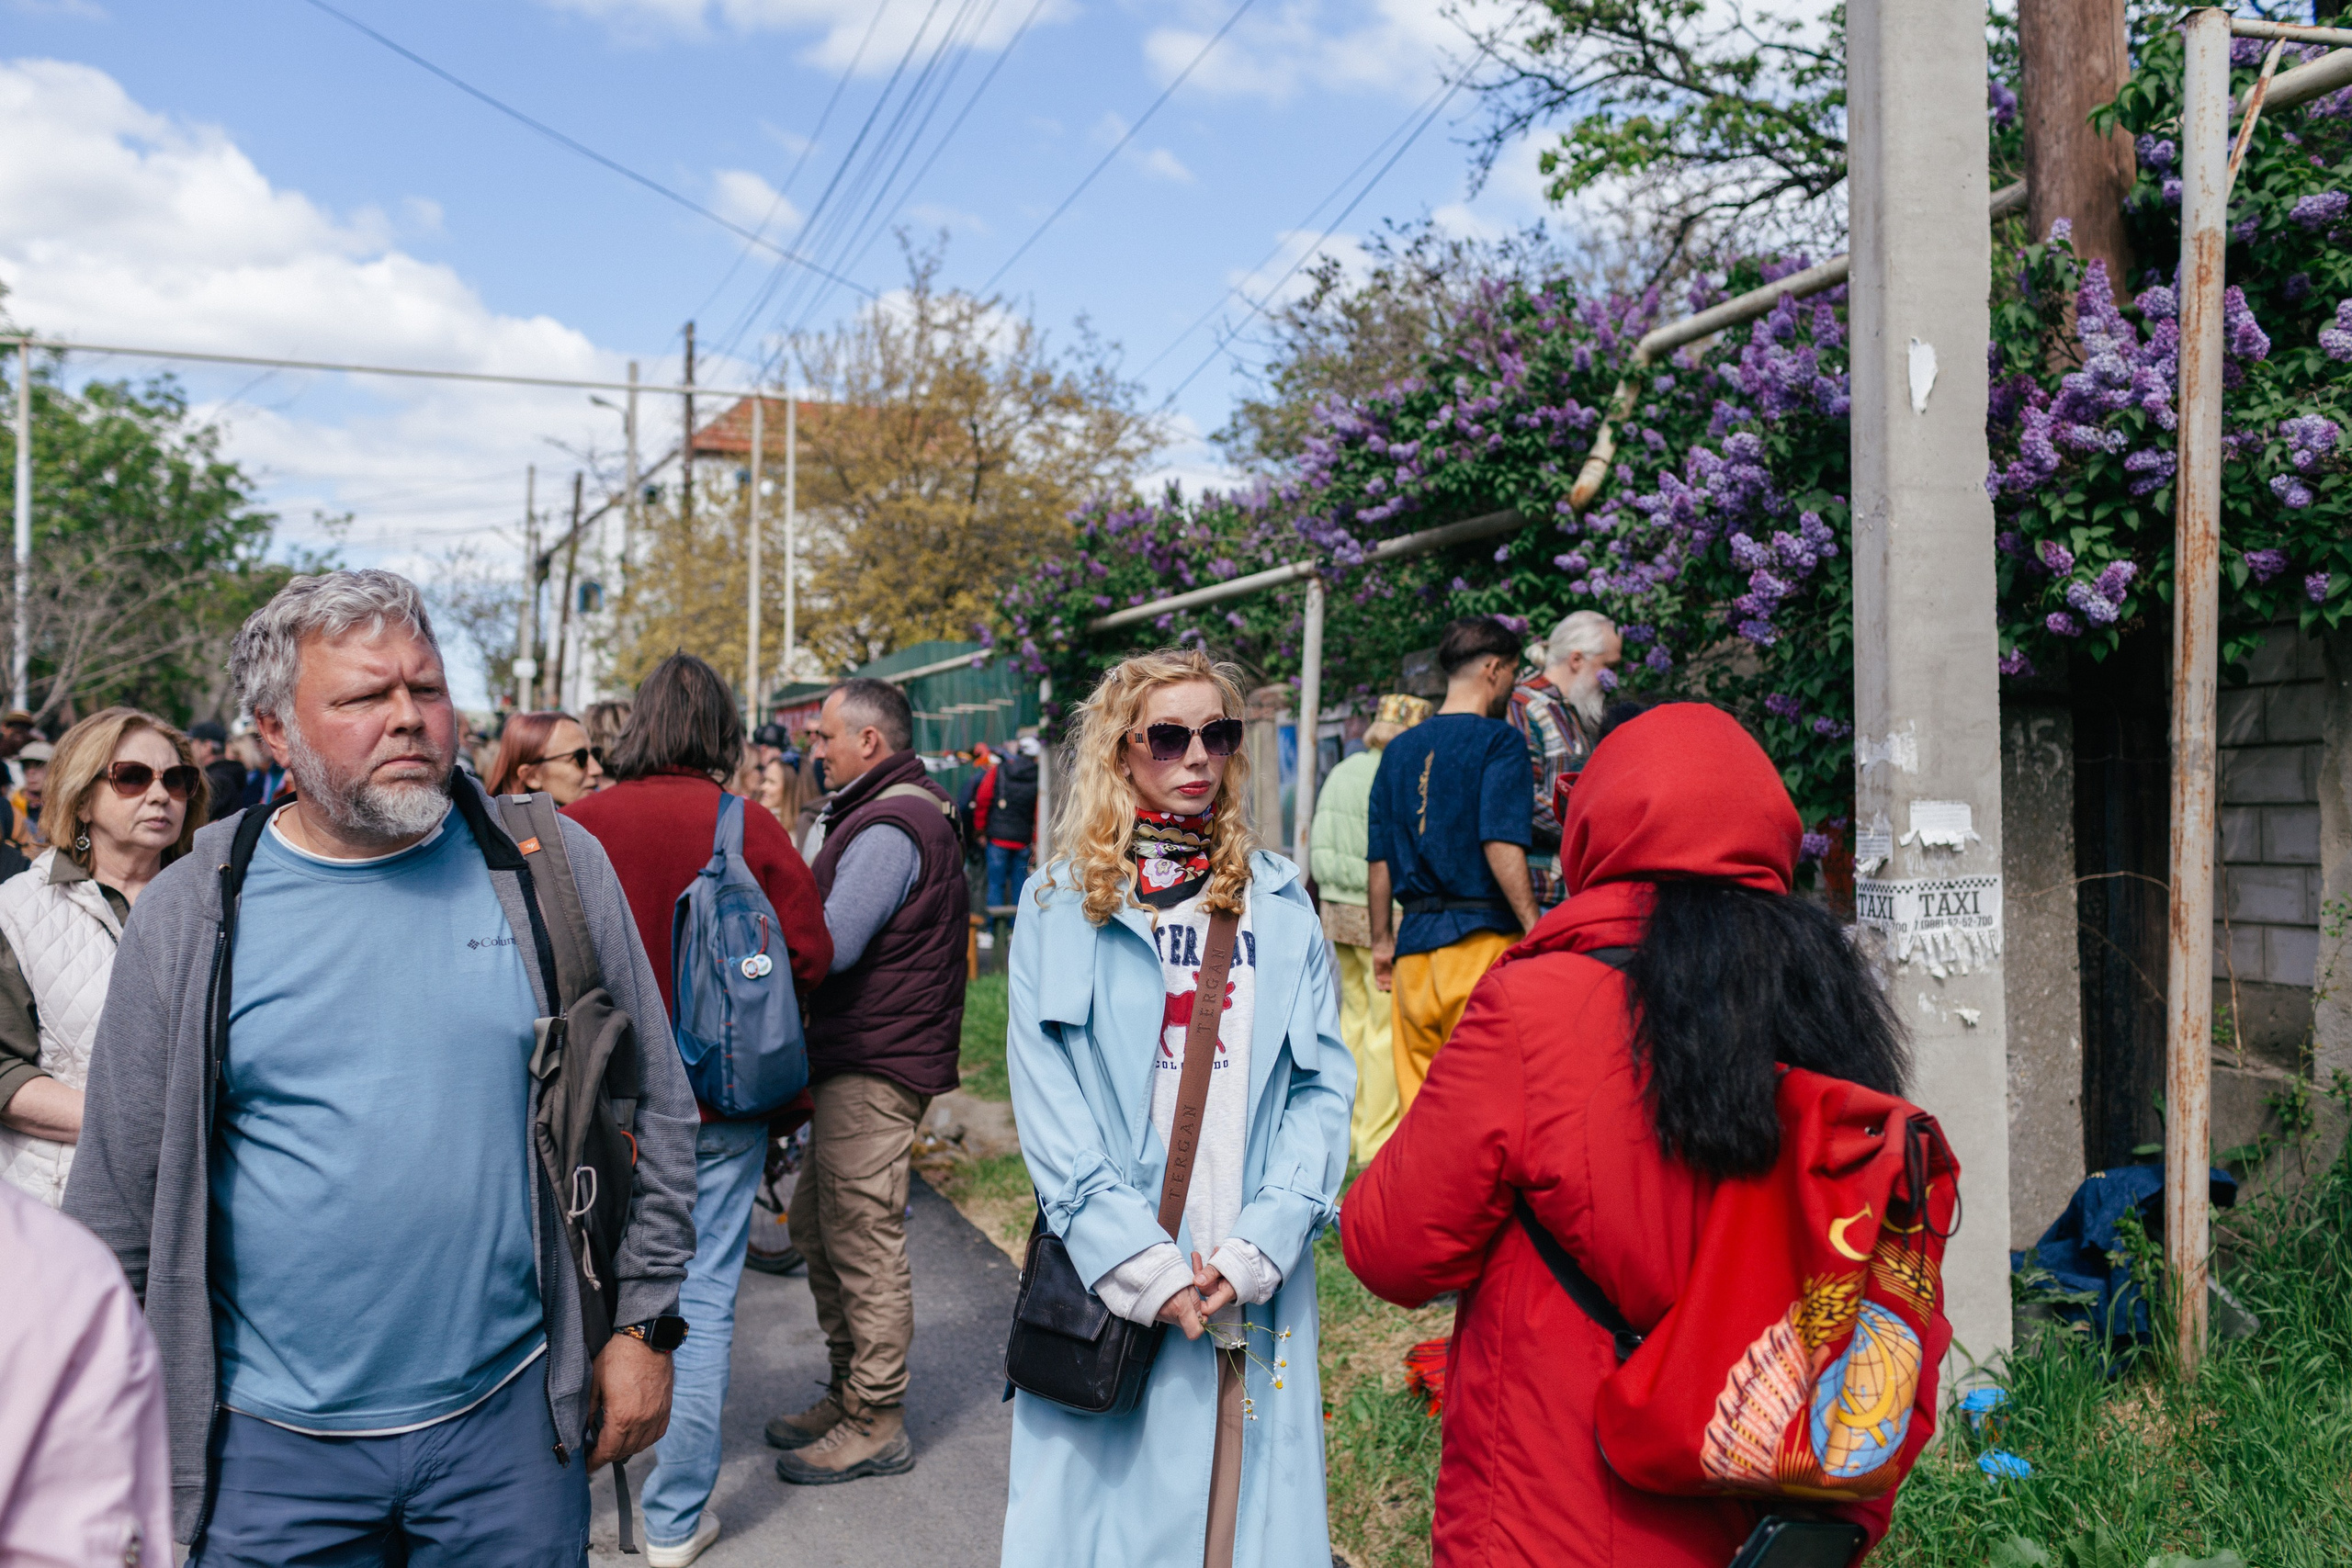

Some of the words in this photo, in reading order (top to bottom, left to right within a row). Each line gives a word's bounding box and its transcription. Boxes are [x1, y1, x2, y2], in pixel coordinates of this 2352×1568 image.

[1858, 893, 1894, 919] TAXI
[1918, 891, 1980, 918] TAXI
[1197, 947, 1226, 1035] TERGAN
[1155, 1059, 1229, 1070] COLDO
[1169, 1105, 1197, 1201] TERGAN
